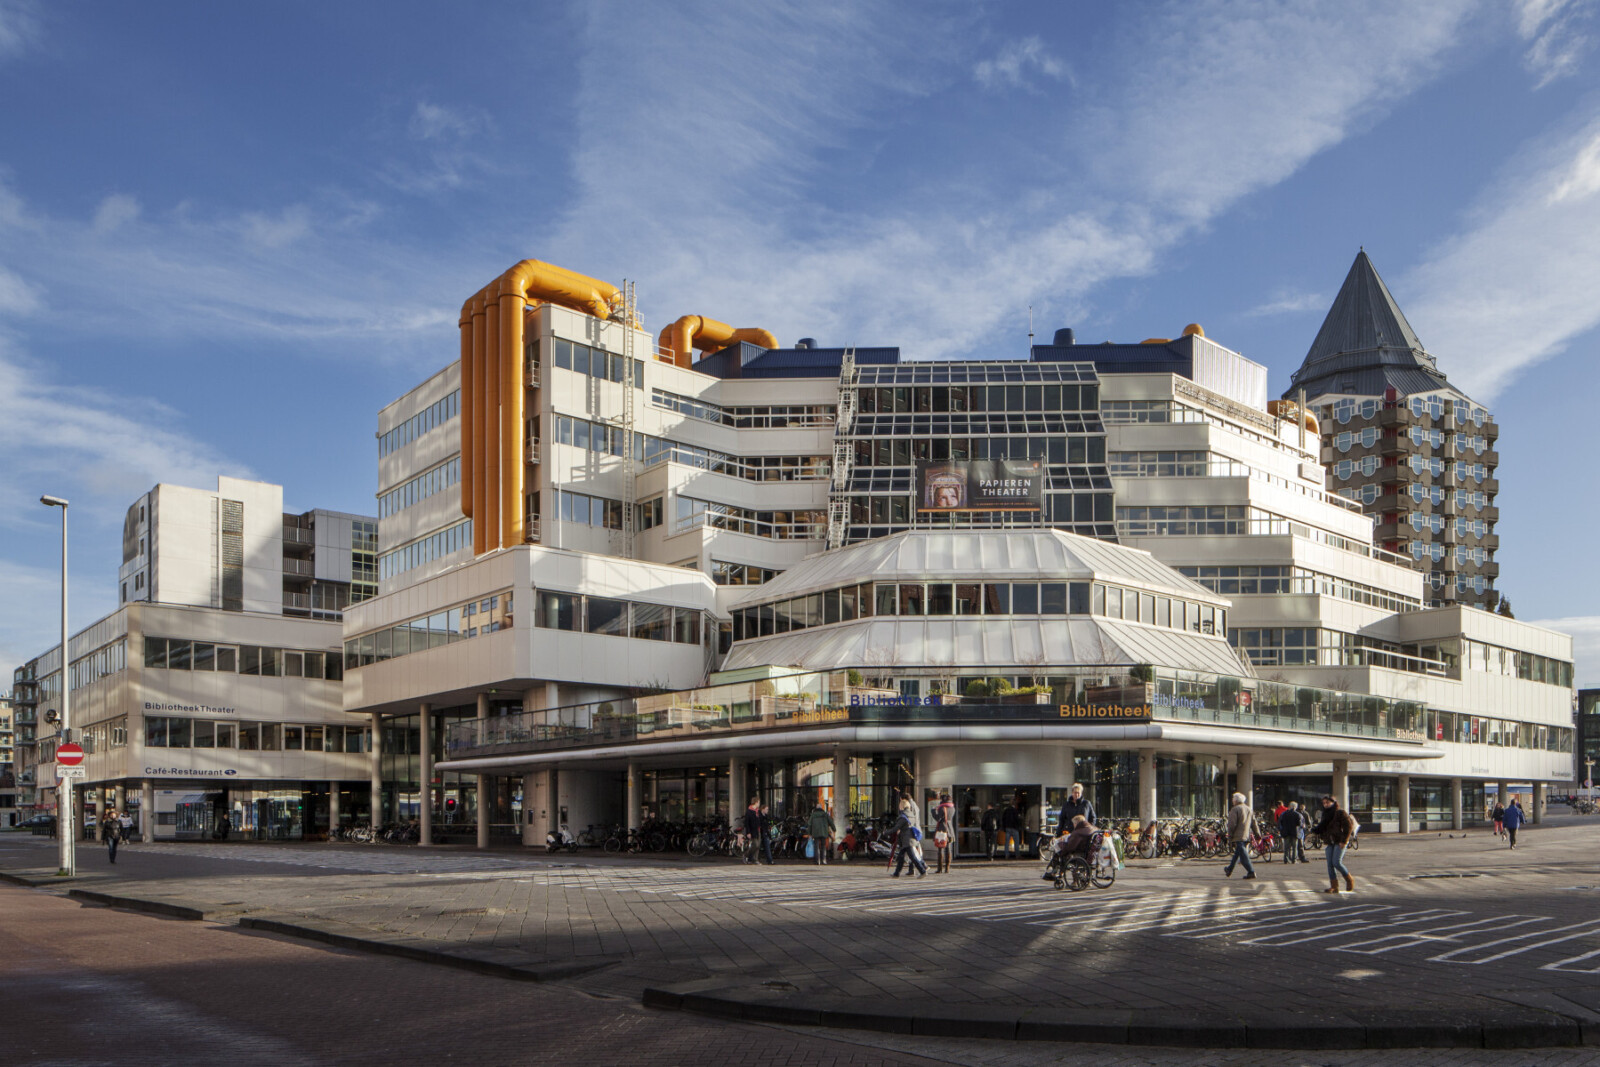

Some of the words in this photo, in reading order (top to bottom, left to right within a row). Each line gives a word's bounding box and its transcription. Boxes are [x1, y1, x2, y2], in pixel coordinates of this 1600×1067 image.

[979, 479, 1031, 487] PAPIEREN
[982, 488, 1029, 496] THEATER
[850, 694, 942, 707] Bibliotheek
[1153, 693, 1205, 709] Bibliotheek
[791, 707, 849, 723] Bibliotheek
[1059, 704, 1152, 717] Bibliotheek
[145, 766, 223, 776] Café-Restaurant
